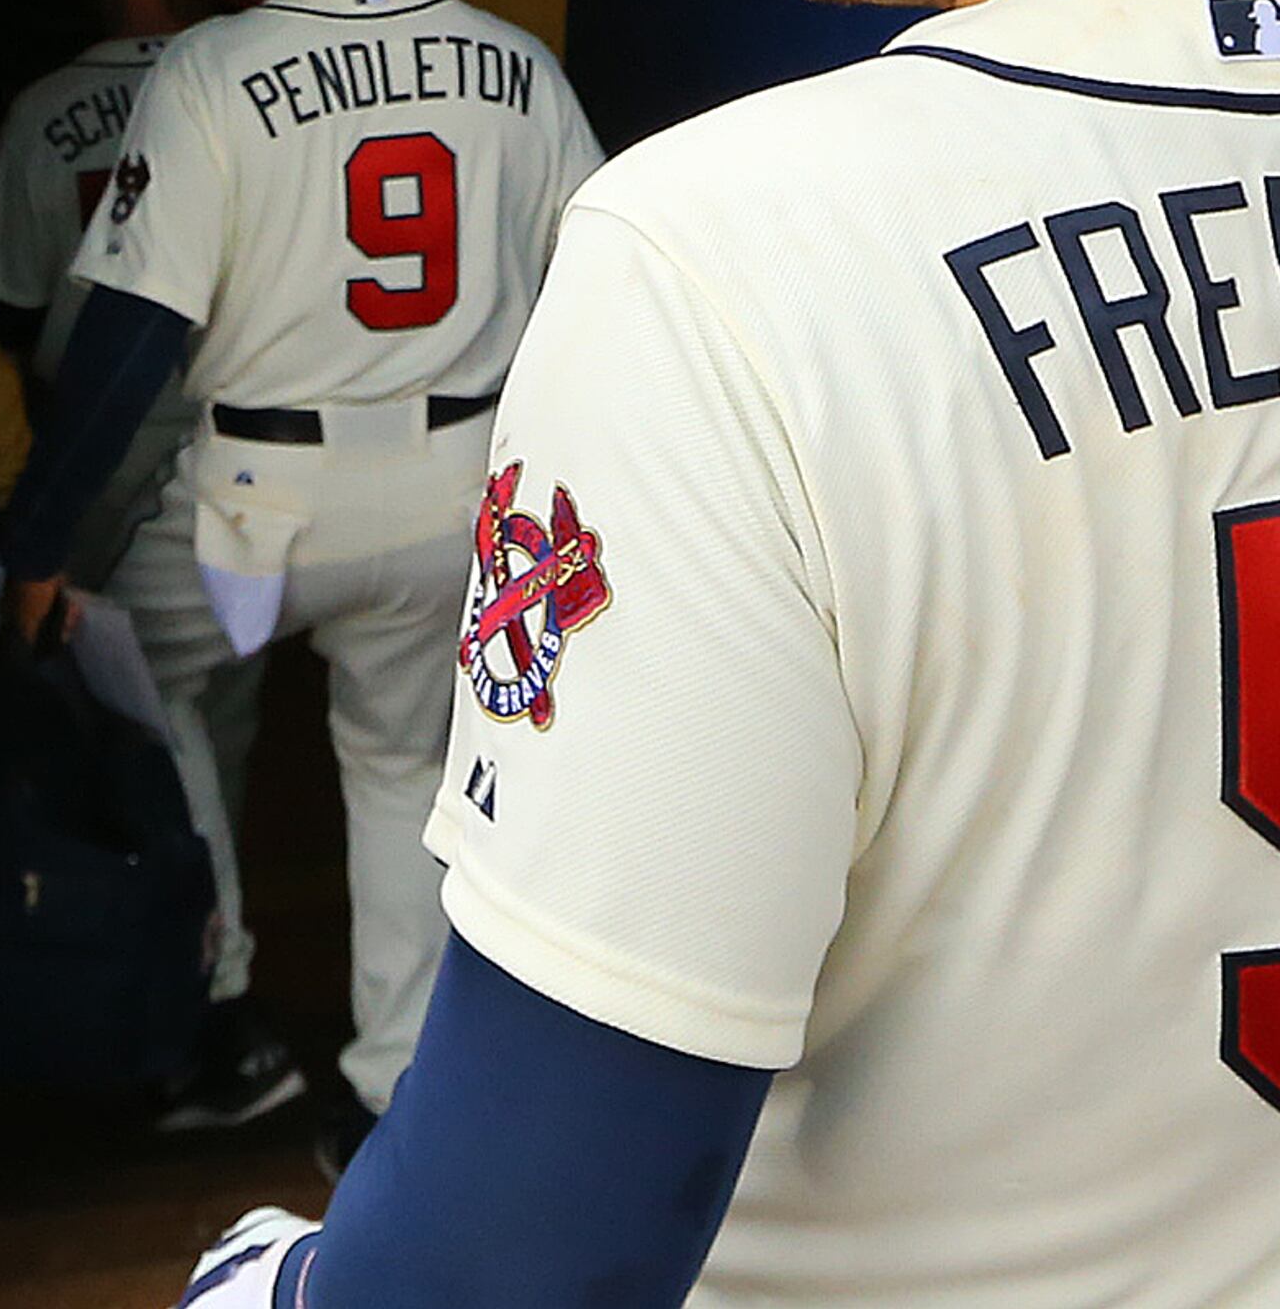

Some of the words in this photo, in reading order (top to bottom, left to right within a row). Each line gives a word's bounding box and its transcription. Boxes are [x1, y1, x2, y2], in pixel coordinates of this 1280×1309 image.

[241, 36, 534, 139] PENDLETON
[344, 130, 461, 333] 9
[496, 630, 562, 716] BRAVES
